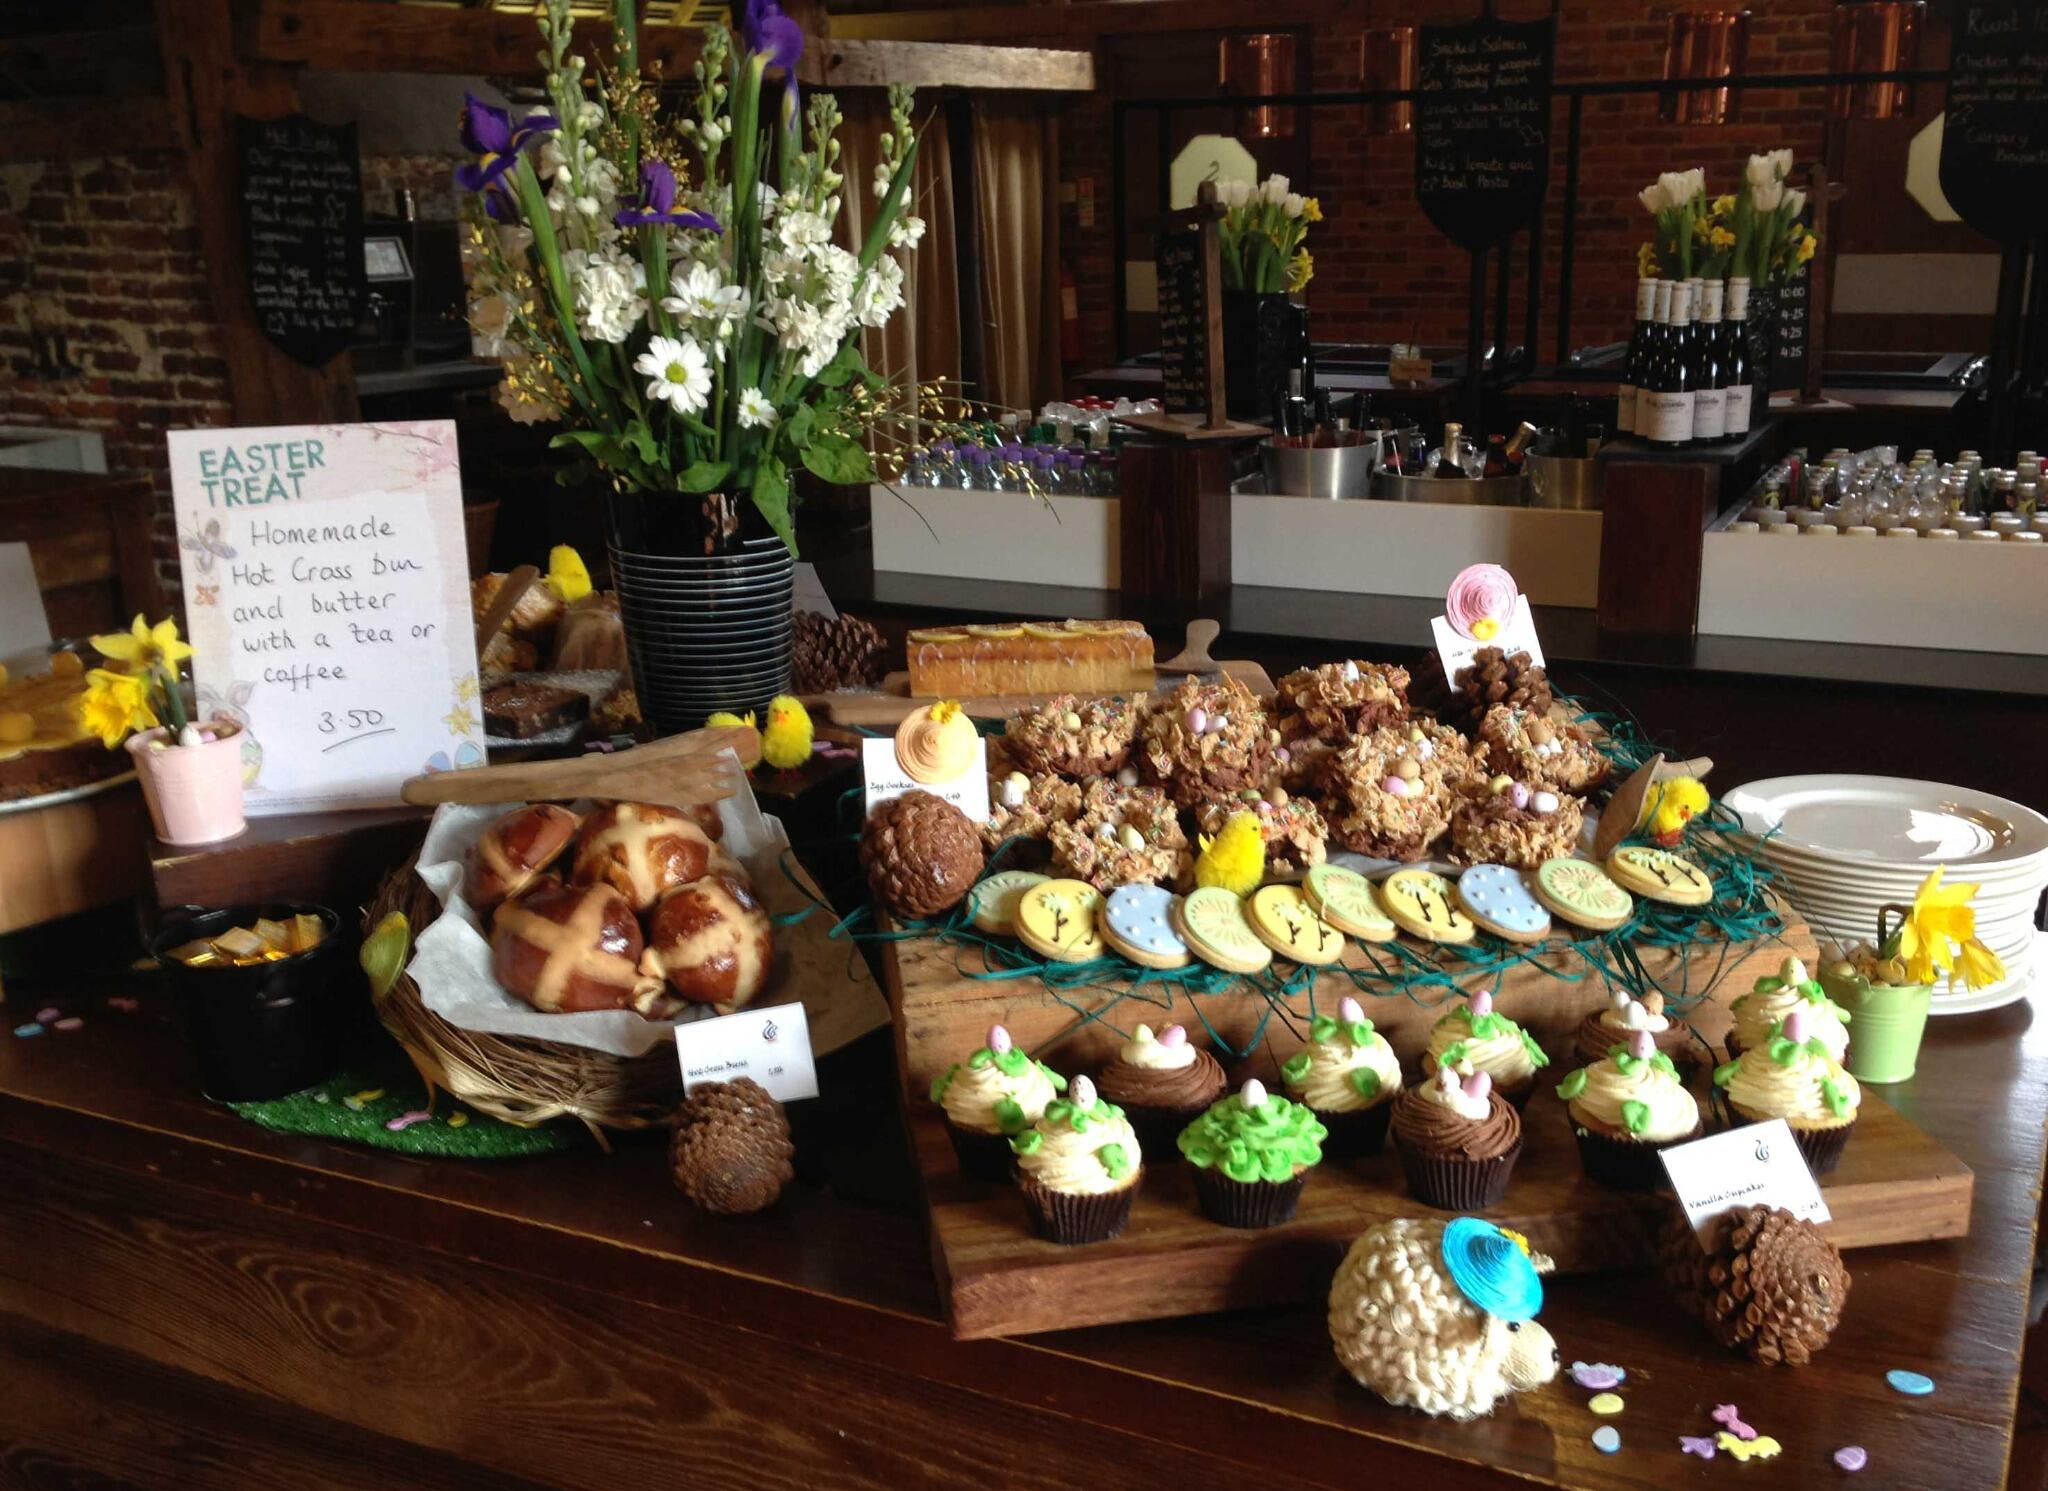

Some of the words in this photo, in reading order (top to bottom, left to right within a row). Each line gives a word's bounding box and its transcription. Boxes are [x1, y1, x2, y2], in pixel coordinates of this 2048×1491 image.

[199, 439, 327, 480] EASTER
[201, 472, 305, 508] TREAT
[251, 515, 396, 547] Homemade
[231, 562, 275, 587] Hot
[292, 556, 352, 582] Cross
[233, 595, 284, 623] and
[311, 590, 396, 613] butter
[243, 626, 295, 653] with
[314, 633, 331, 648] a
[350, 622, 393, 645] tea
[411, 622, 435, 639] or
[263, 663, 346, 692] coffee
[318, 708, 384, 734] 3.50
[869, 781, 885, 793] Egg
[1689, 1194, 1723, 1209] Vanilla
